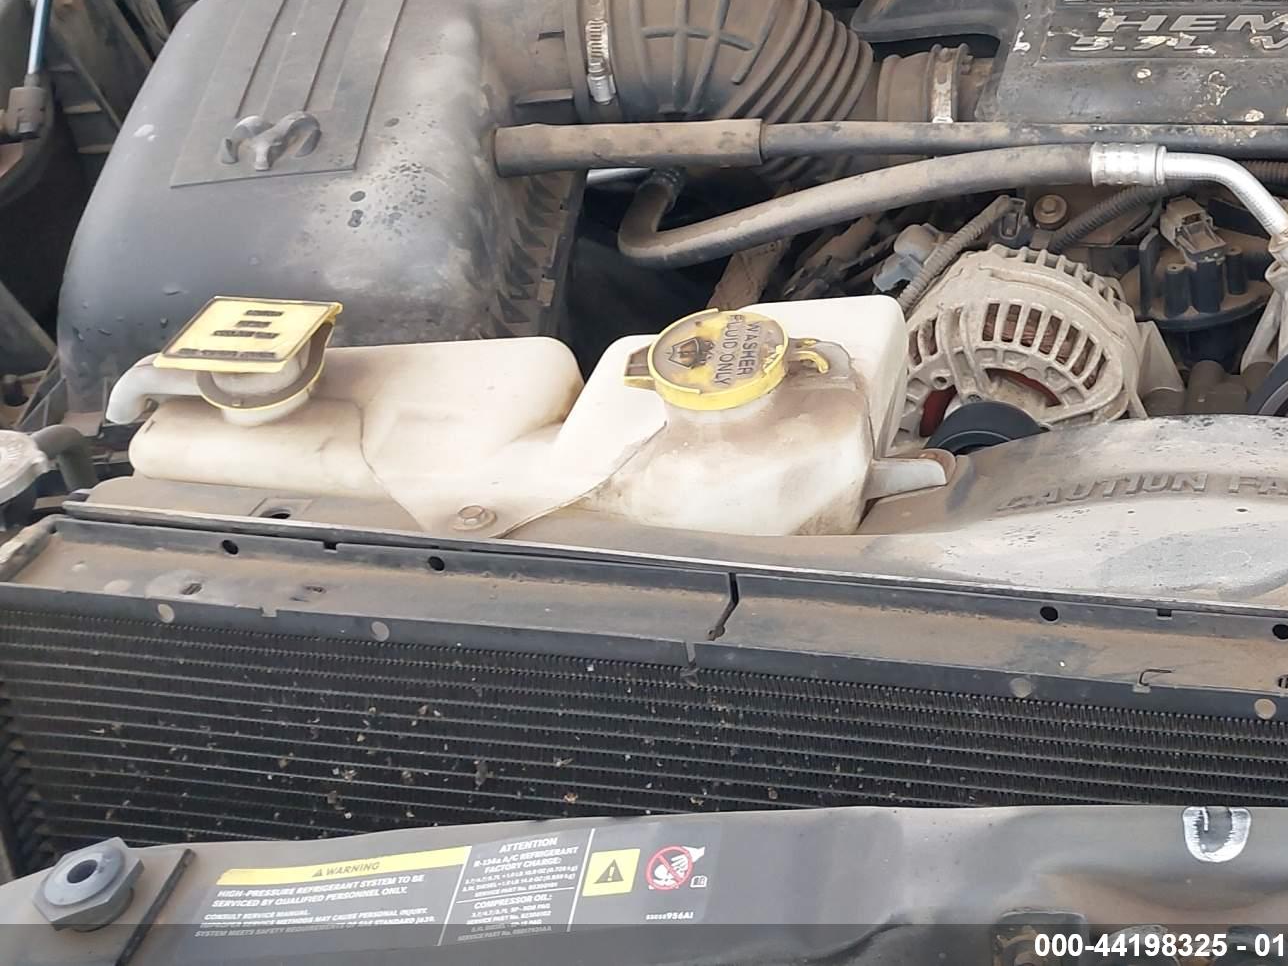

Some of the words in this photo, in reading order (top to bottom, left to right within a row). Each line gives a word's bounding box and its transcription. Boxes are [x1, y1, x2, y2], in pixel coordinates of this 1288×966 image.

[1069, 35, 1211, 52] 5.7L
[718, 313, 744, 353] FLUID
[736, 321, 762, 376] WASHER
[713, 352, 736, 386] ONLY
[499, 837, 558, 853] ATTENTION
[502, 853, 519, 864] A/C
[520, 846, 580, 861] REFRIGERANT
[326, 862, 381, 876] WARNING
[484, 861, 522, 874] FACTORY
[217, 887, 295, 898] HIGH-PRESSURE
[297, 880, 361, 895] REFRIGERANT
[360, 877, 397, 888] SYSTEM
[398, 875, 411, 884] TO
[412, 874, 425, 883] BE
[212, 898, 260, 908] SERVICED
[261, 897, 275, 907] BY
[275, 894, 324, 906] QUALIFIED
[325, 890, 381, 902] PERSONNEL
[474, 895, 532, 910] COMPRESSOR
